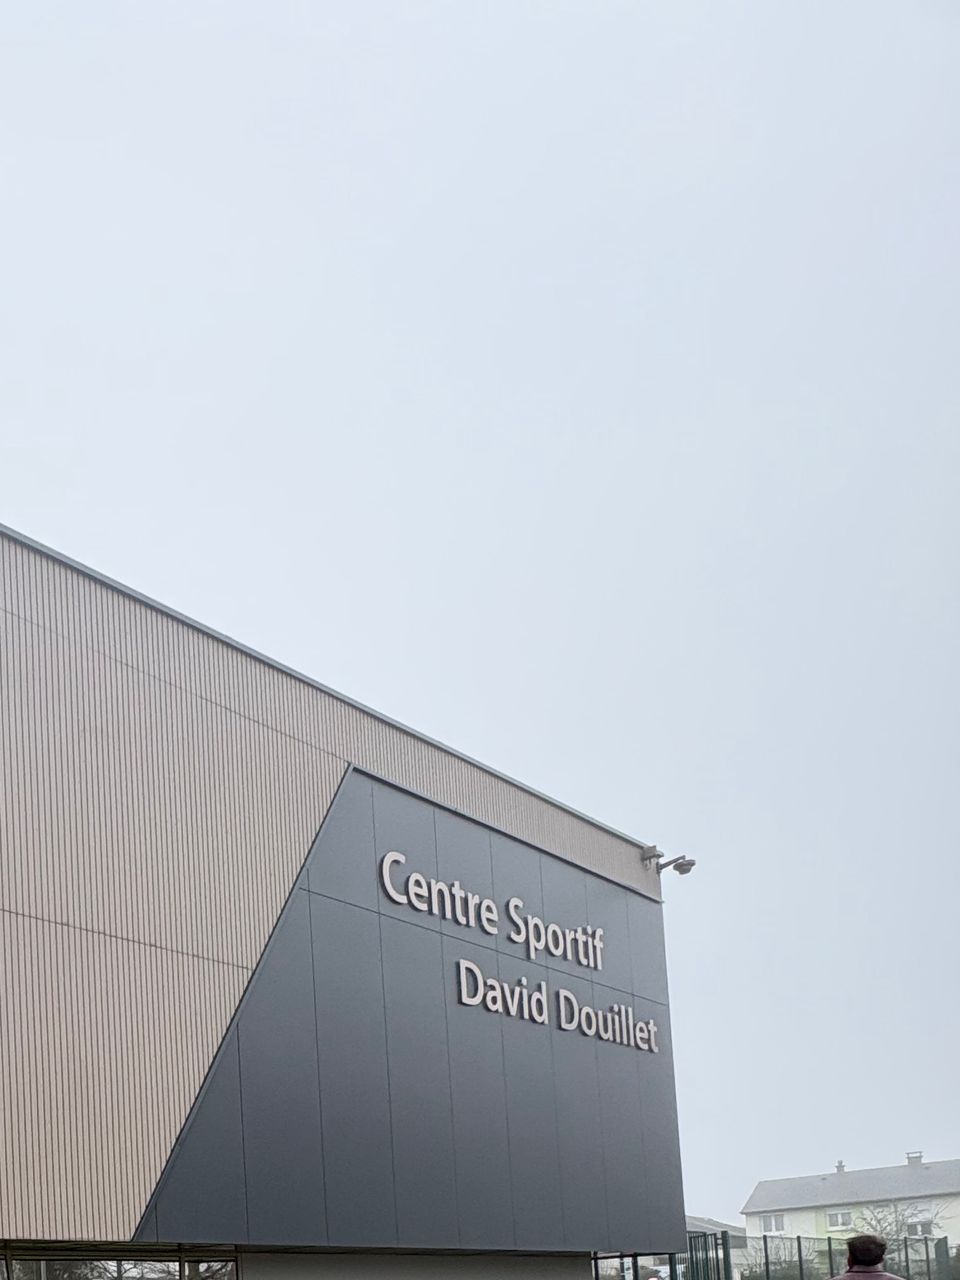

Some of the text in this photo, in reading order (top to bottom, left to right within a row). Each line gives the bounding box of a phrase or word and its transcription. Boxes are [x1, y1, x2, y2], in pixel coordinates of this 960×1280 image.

[381, 851, 604, 970] Centre Sportif
[458, 958, 658, 1052] David Douillet
